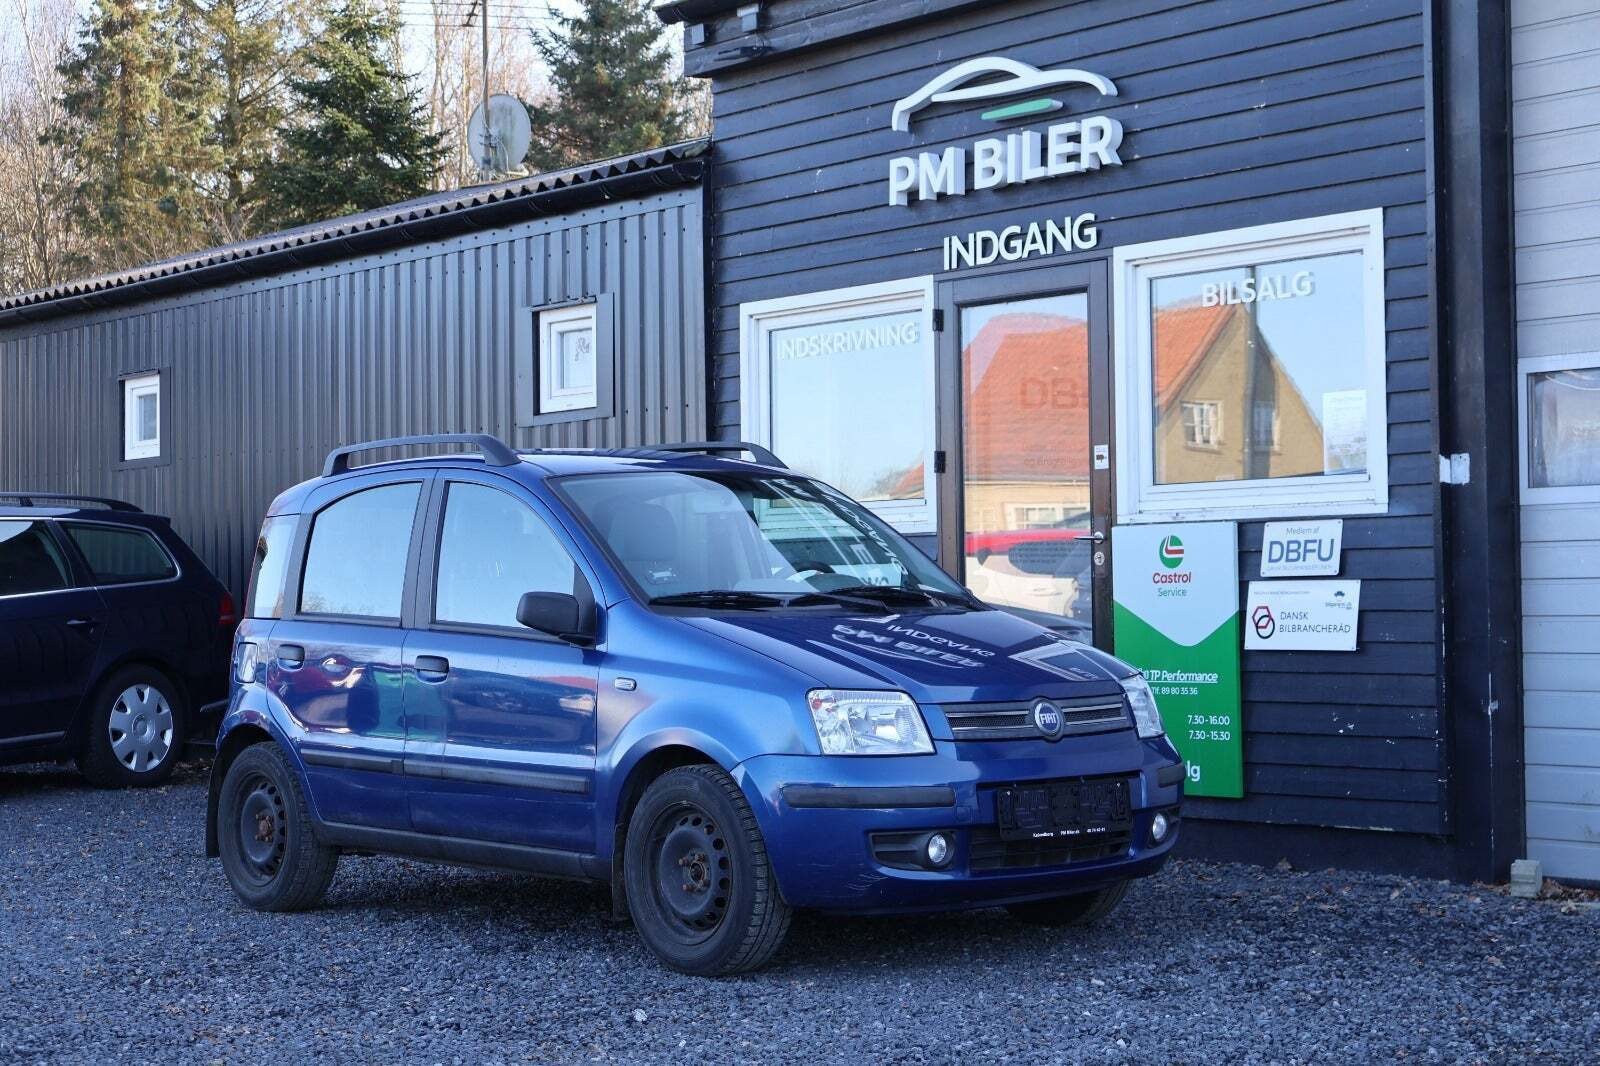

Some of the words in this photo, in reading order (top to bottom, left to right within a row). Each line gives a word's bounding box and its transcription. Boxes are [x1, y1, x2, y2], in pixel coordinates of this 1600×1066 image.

[889, 146, 965, 206] PM
[974, 116, 1123, 190] BILER
[943, 213, 1098, 271] INDGANG
[1201, 271, 1316, 307] BILSALG
[776, 321, 920, 360] INDSKRIVNING
[1267, 538, 1335, 563] DBFU
[1153, 571, 1191, 584] Castrol
[1158, 587, 1187, 597] Service
[1280, 611, 1308, 620] DANSK
[1279, 623, 1351, 633] BILBRANCHERÅD
[1150, 670, 1160, 680] TP
[1162, 670, 1218, 681] Performance
[1161, 687, 1170, 695] 89
[1171, 687, 1179, 695] 80
[1180, 687, 1188, 695] 35
[1189, 687, 1198, 695] 36
[1040, 713, 1056, 724] FIAT
[1185, 760, 1200, 782] lg
